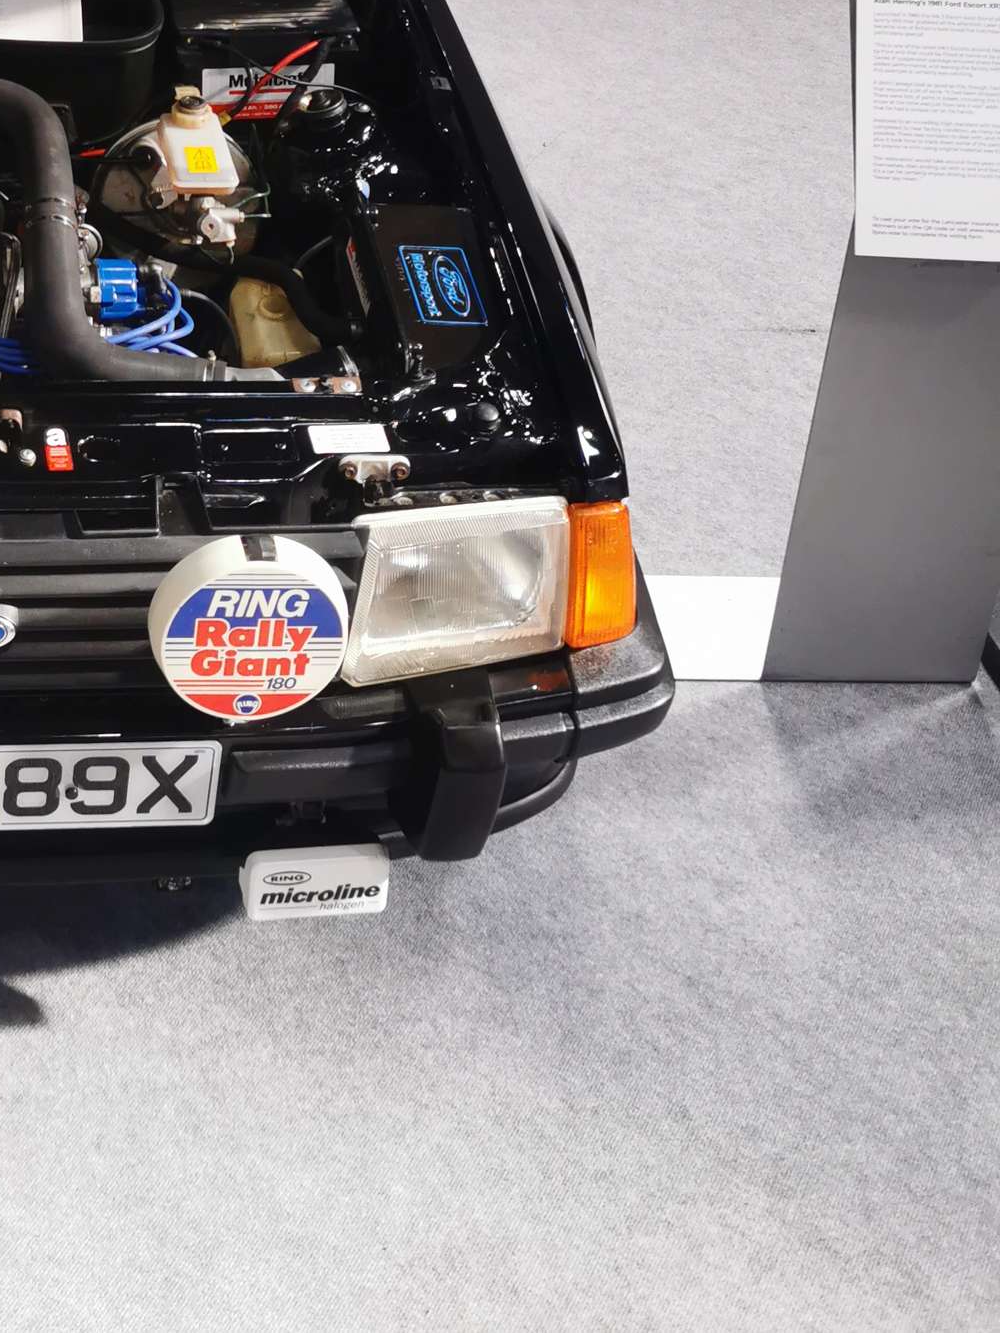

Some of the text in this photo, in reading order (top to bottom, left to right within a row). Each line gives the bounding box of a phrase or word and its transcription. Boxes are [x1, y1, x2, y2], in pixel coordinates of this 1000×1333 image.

[408, 252, 443, 317] Motorsport
[207, 588, 310, 619] RING
[194, 618, 317, 652] Rally
[190, 650, 310, 677] Giant
[266, 677, 297, 691] 180
[236, 699, 260, 711] RING
[269, 873, 305, 883] RING
[259, 882, 381, 905] microline
[318, 900, 365, 912] halogen
